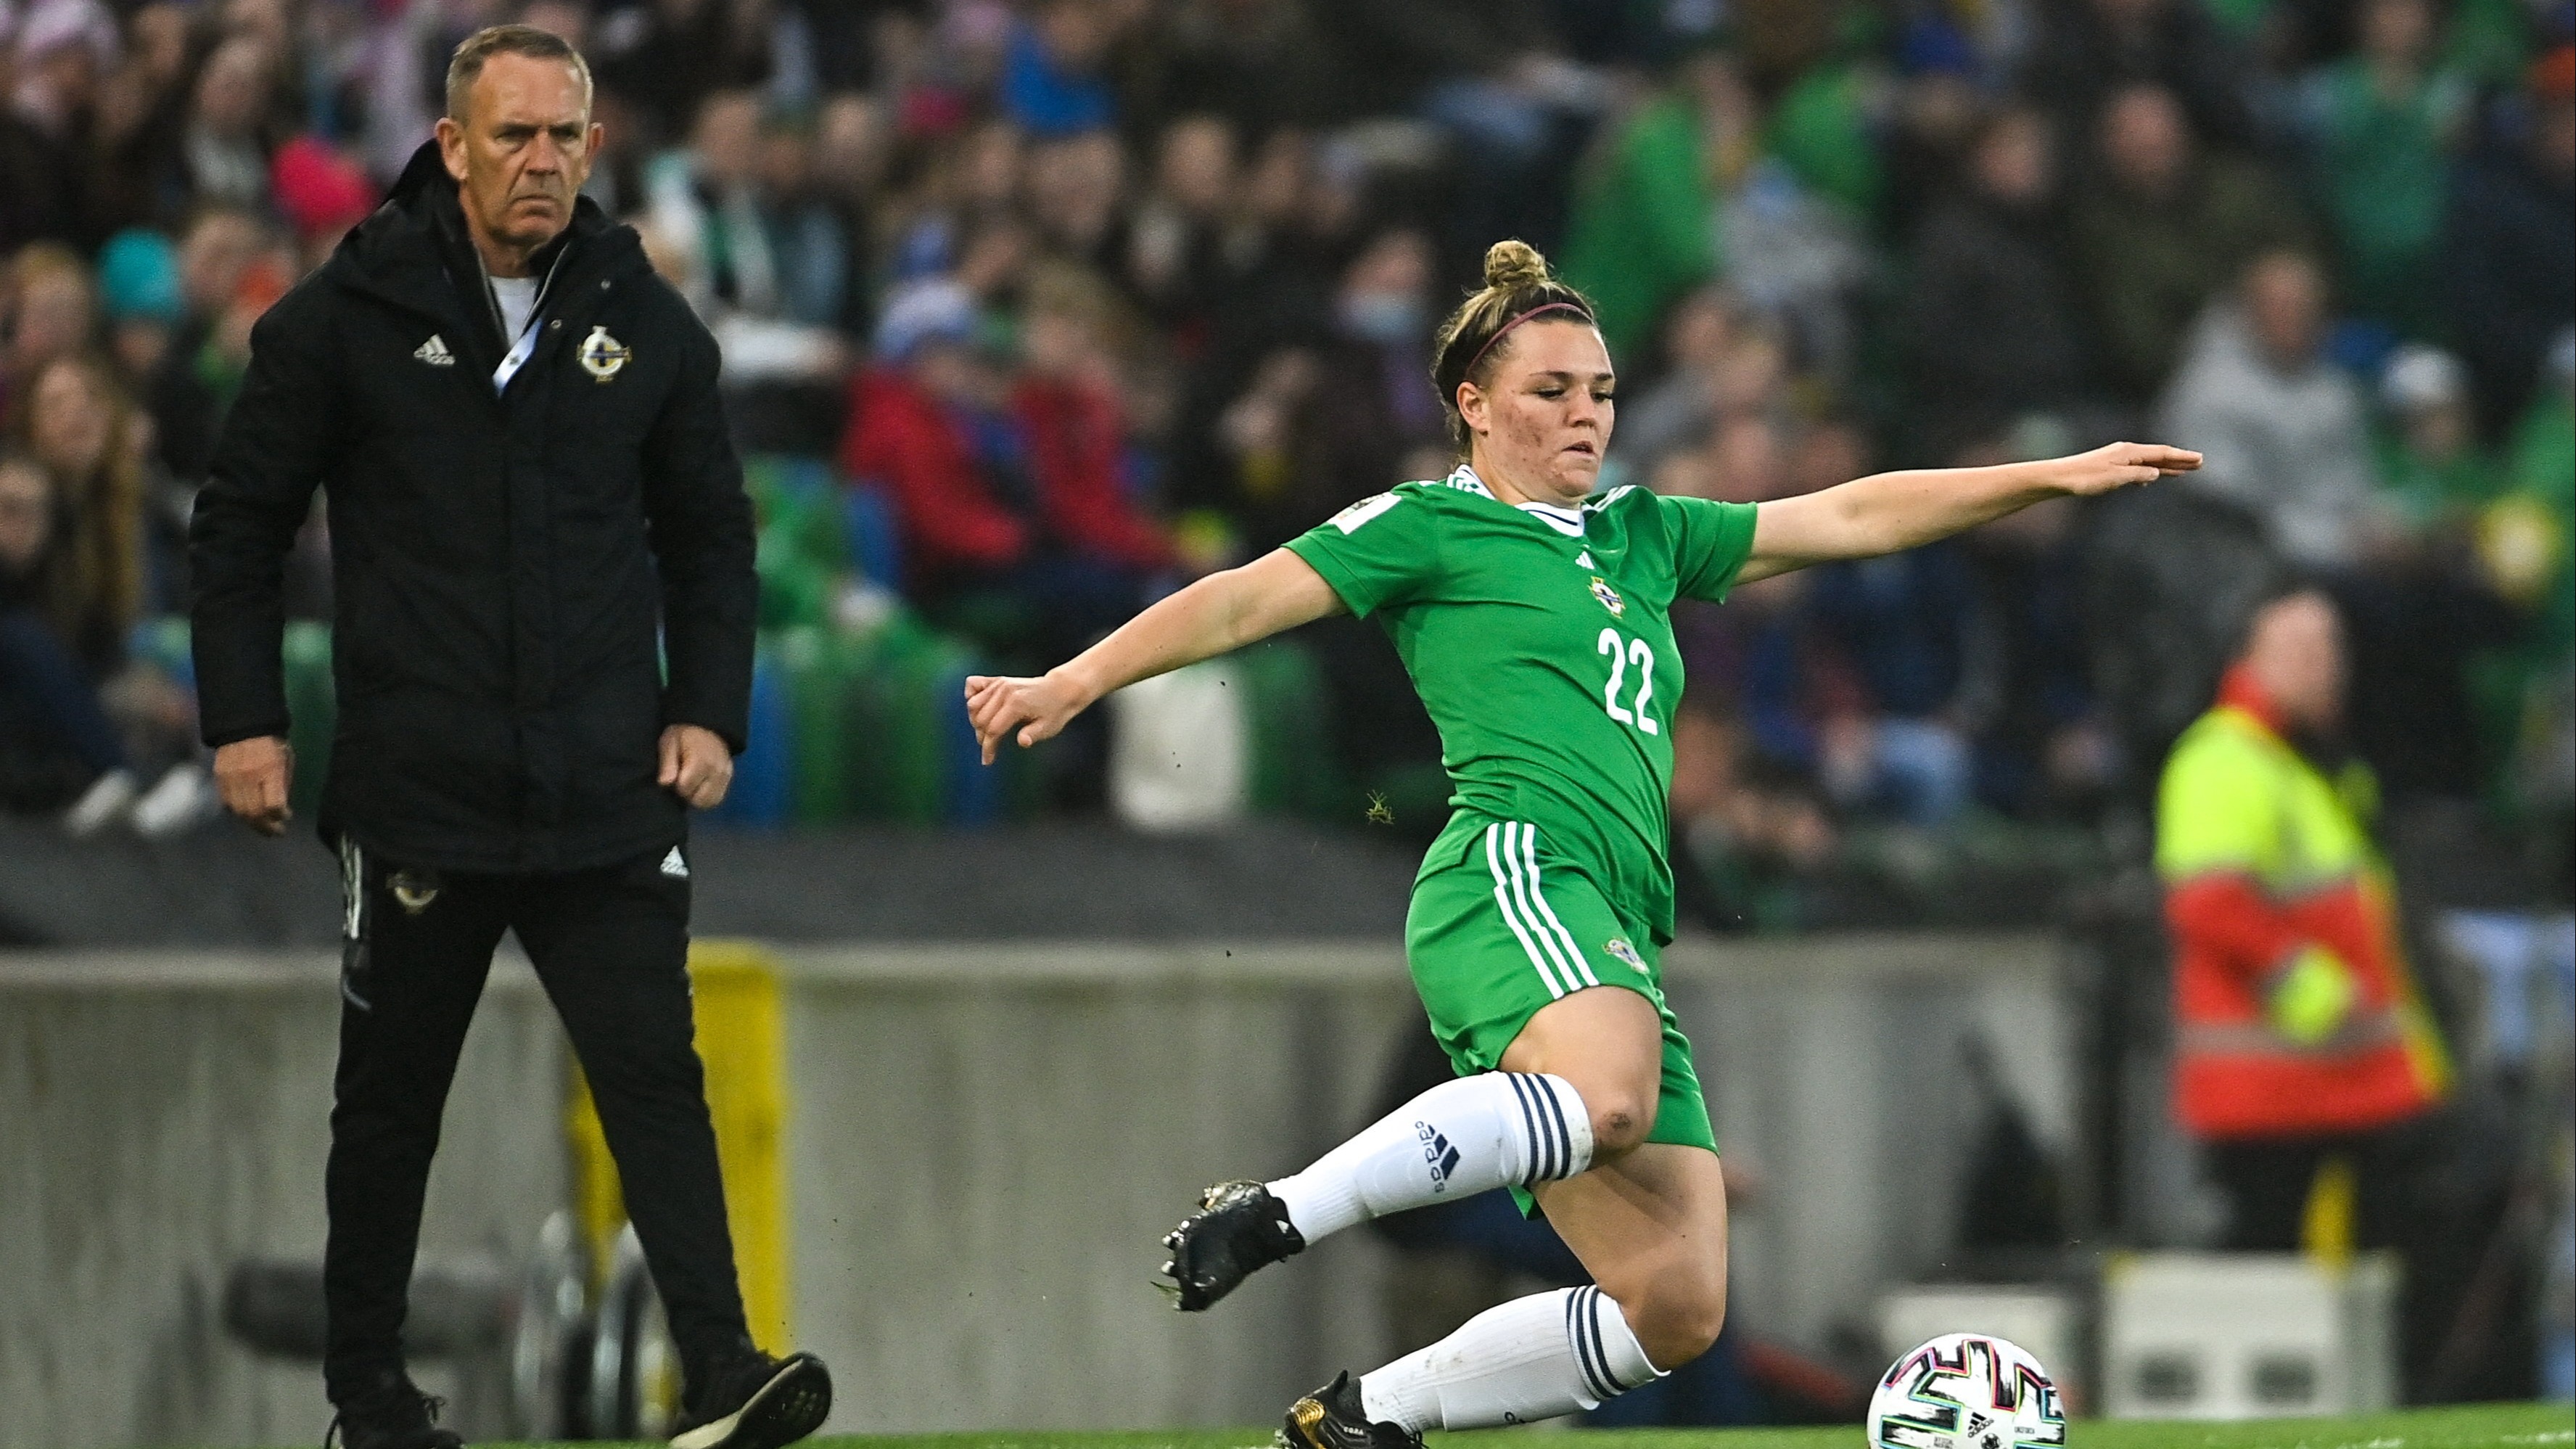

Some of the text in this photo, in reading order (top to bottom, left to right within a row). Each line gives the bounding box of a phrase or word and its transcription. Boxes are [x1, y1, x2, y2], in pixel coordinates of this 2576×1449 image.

[1598, 628, 1658, 736] 22
[1415, 1121, 1444, 1193] adidas
[1967, 1418, 1995, 1437] adidas
